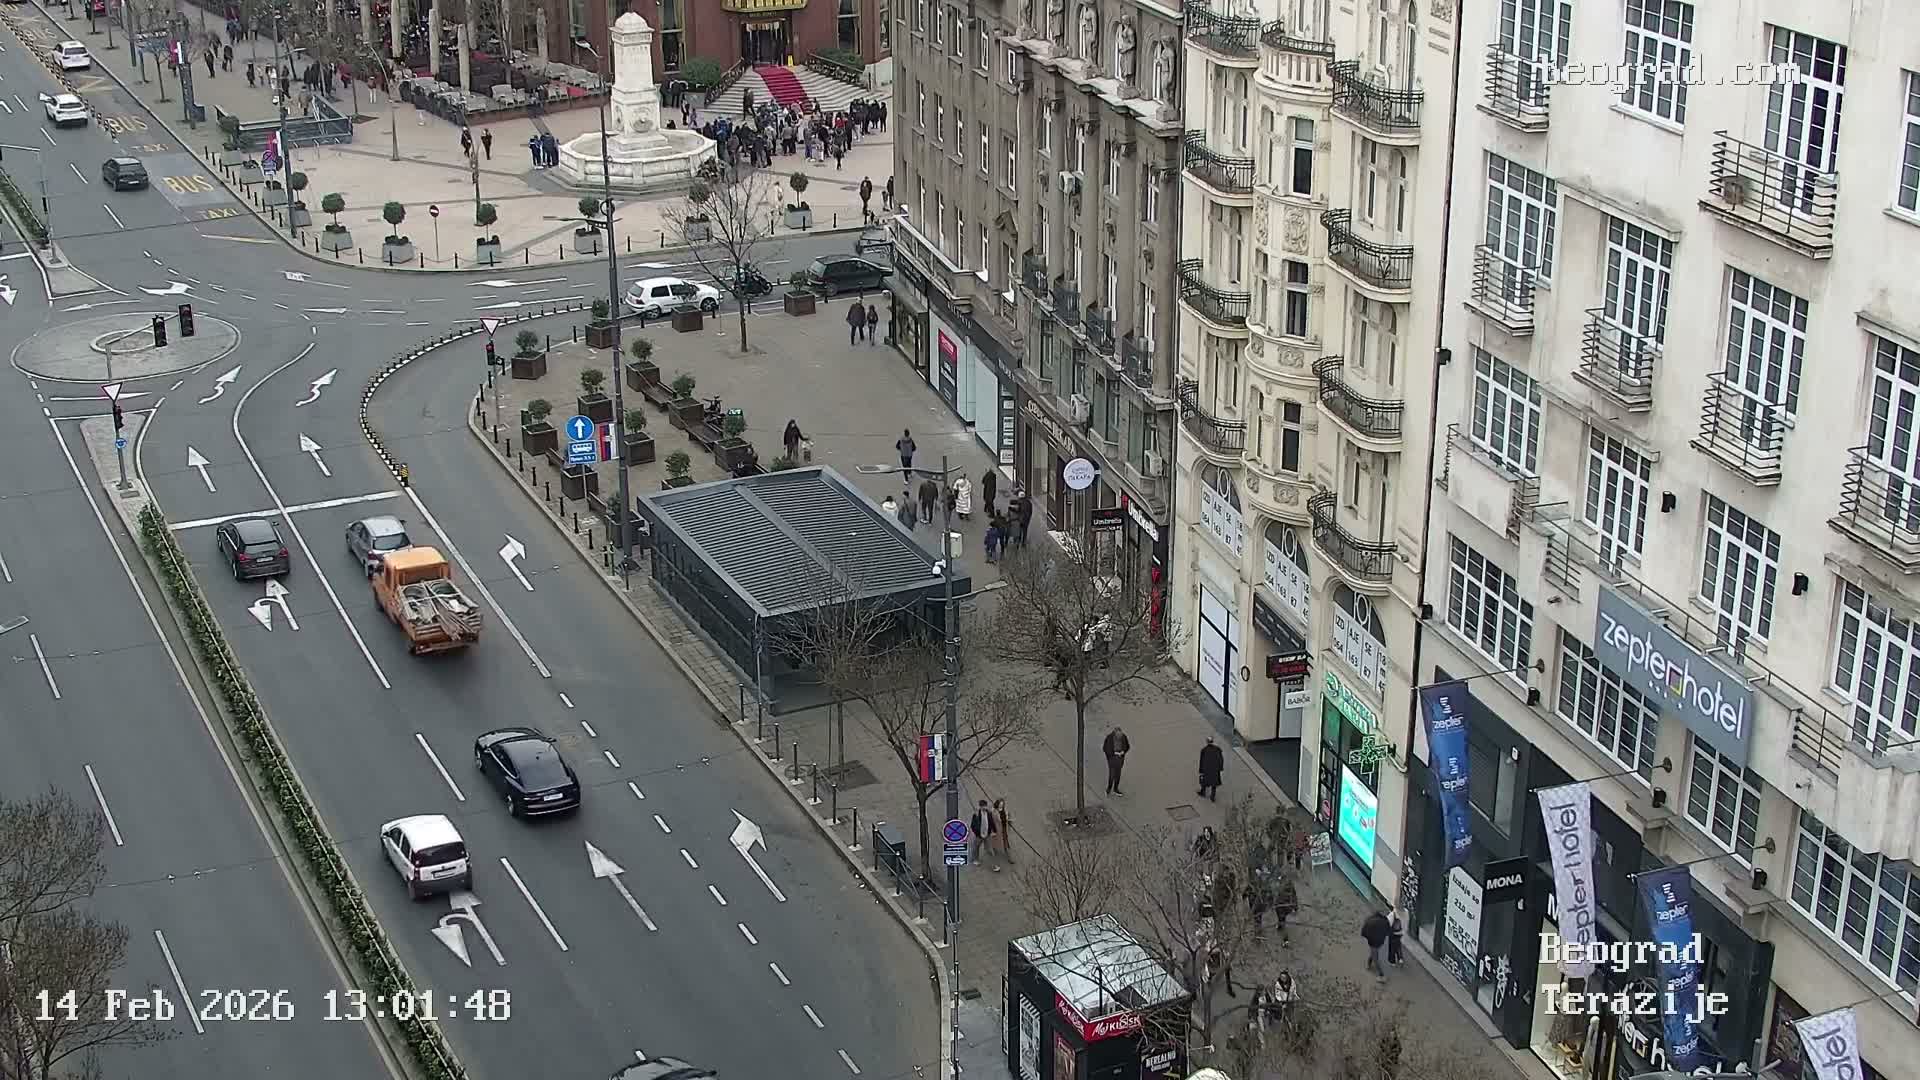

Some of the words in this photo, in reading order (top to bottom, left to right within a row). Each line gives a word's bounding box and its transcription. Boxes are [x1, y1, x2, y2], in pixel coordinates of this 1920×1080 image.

[105, 116, 148, 132] BUS
[162, 175, 214, 193] BUS
[195, 208, 239, 220] TAXI
[1432, 714, 1464, 731] zepter
[1487, 873, 1523, 890] MONA
[1657, 901, 1689, 921] zepter
